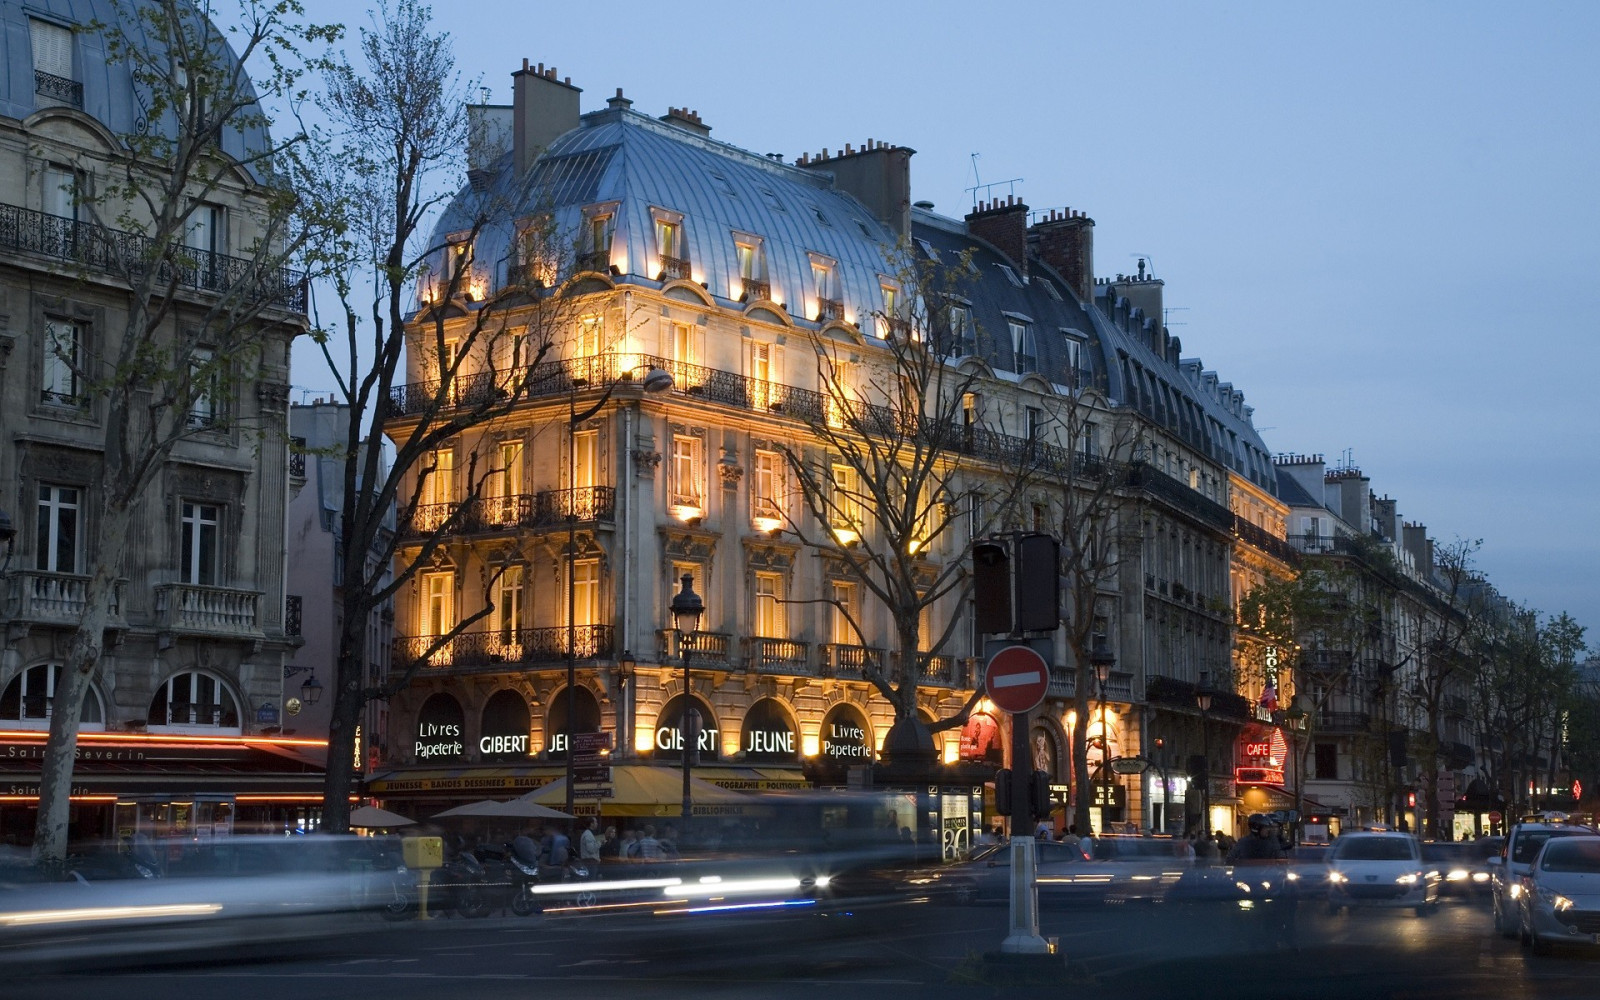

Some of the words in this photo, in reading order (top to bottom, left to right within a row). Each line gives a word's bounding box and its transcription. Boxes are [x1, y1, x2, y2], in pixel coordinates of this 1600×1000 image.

[419, 722, 460, 737] Livres
[830, 723, 865, 740] Livres
[479, 735, 529, 754] GIBERT
[656, 726, 718, 751] GIBRT
[747, 731, 795, 753] JEUNE
[74, 749, 144, 760] Severin
[415, 741, 463, 759] Papeterie
[824, 741, 872, 758] Papeterie
[385, 781, 424, 791] JEUNESSE
[431, 779, 462, 789] BANDES
[514, 777, 543, 787] BEAUX
